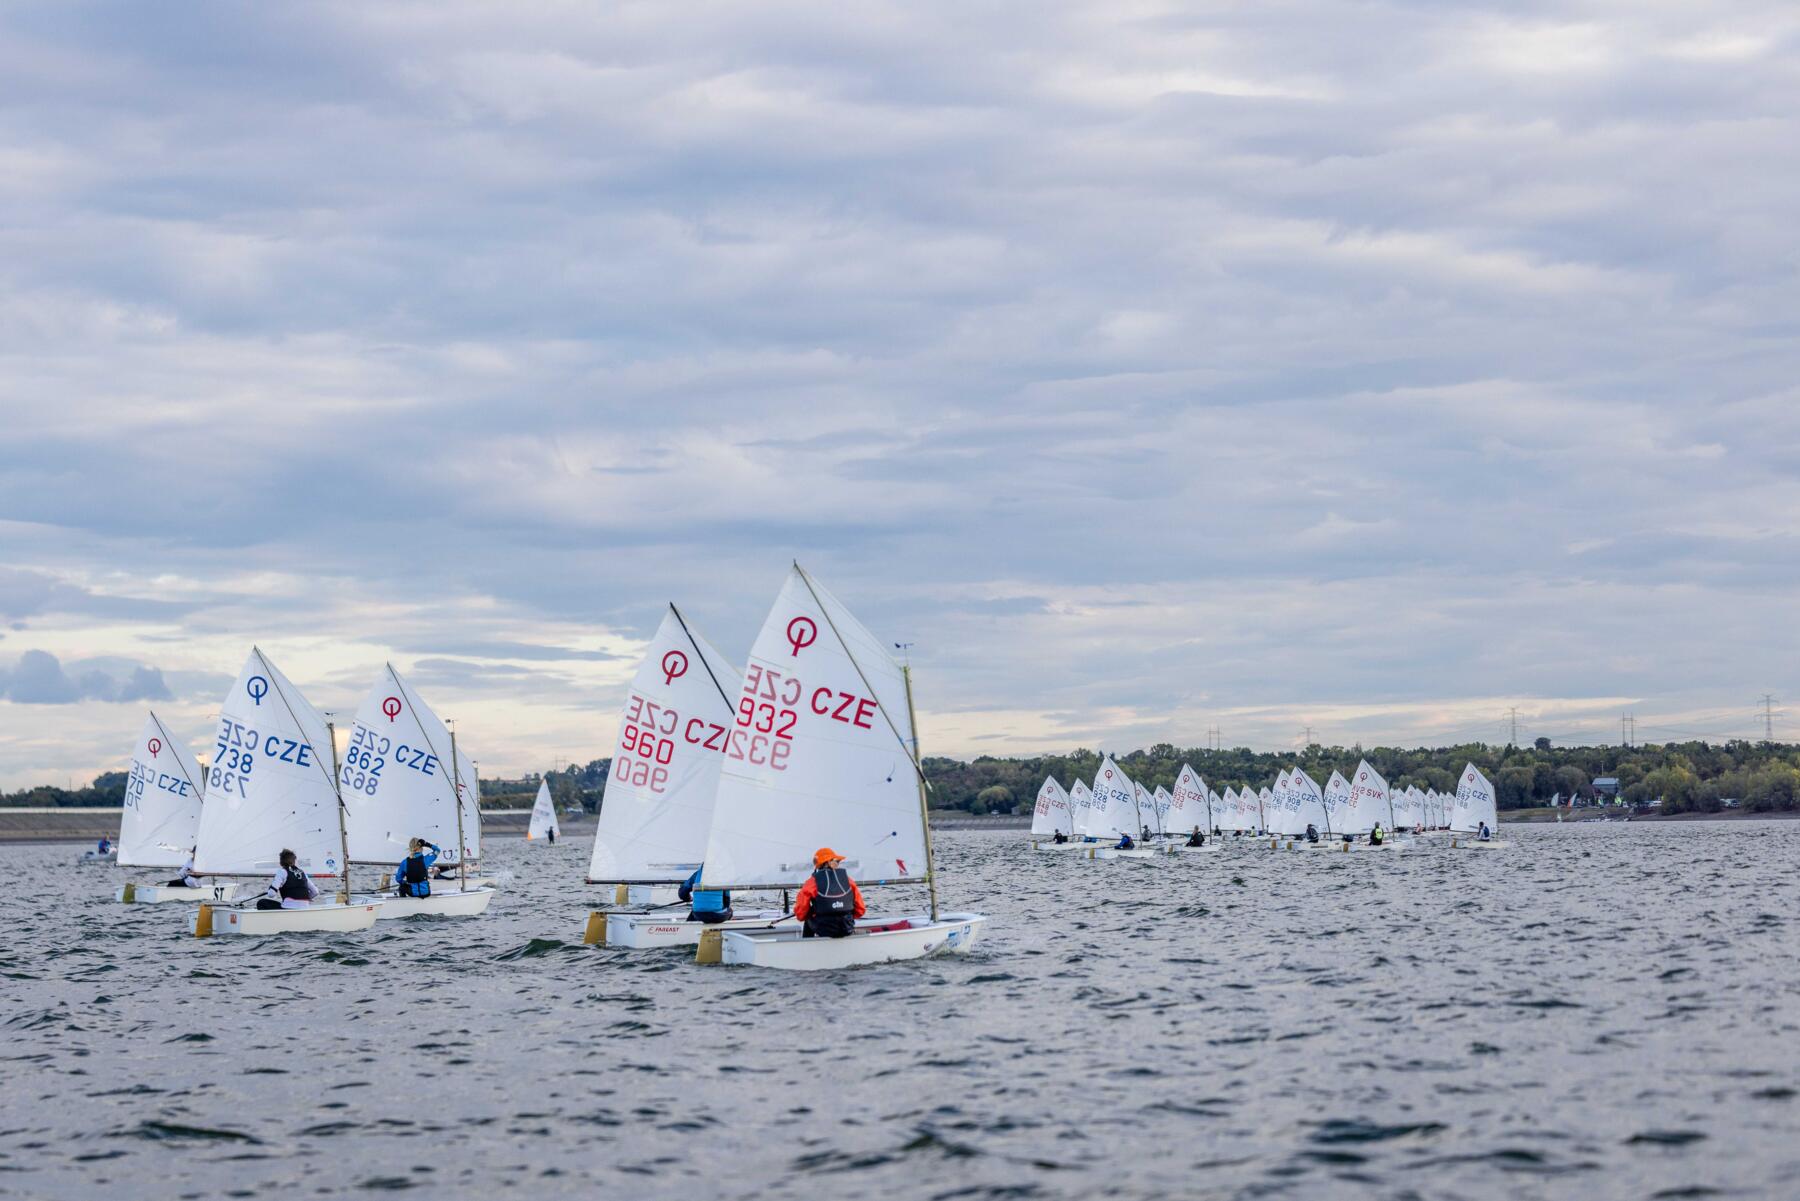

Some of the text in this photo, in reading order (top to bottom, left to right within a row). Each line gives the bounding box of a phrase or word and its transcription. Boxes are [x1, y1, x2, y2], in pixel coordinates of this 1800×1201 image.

[736, 697, 798, 740] 932
[811, 687, 878, 730] CZE
[264, 736, 312, 767] CZE
[622, 724, 674, 765] 960
[214, 742, 253, 774] 738
[347, 746, 385, 777] 862
[395, 745, 438, 776] CZE
[129, 775, 144, 795] 70
[158, 773, 192, 797] CZE
[1366, 789, 1384, 799] SVK
[1472, 790, 1489, 801] CZE
[1052, 800, 1066, 809] CZE
[1094, 790, 1108, 803] 928
[1111, 790, 1130, 803] CZE
[1188, 791, 1203, 802] CZE
[1302, 793, 1318, 803] CZE
